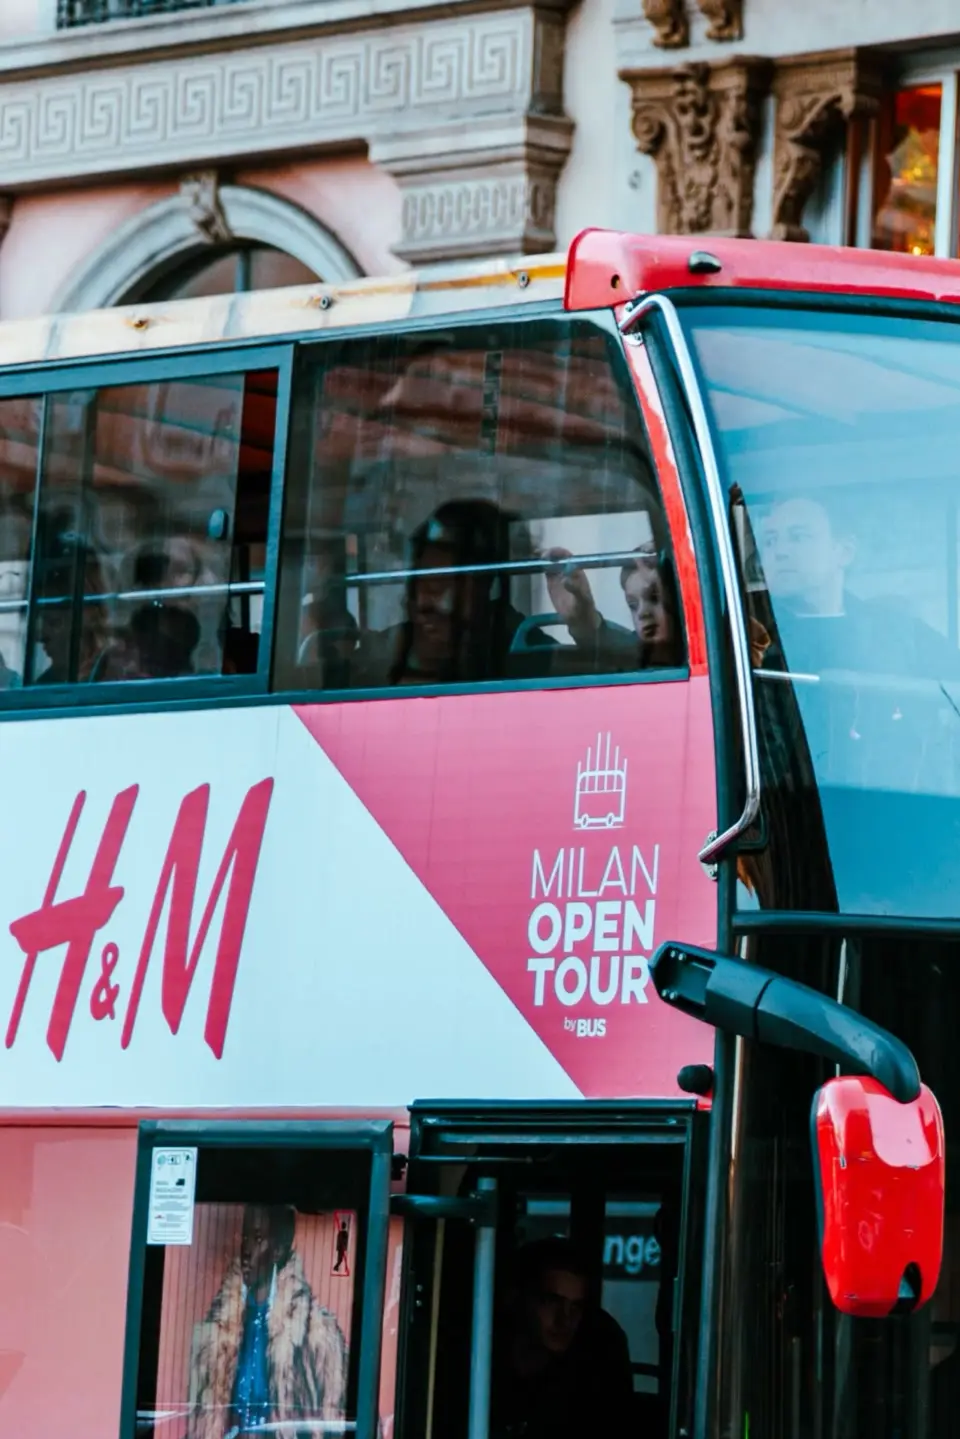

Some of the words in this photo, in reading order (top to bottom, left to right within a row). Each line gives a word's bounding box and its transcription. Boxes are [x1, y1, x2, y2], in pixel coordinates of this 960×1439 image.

[530, 843, 660, 899] MILAN
[5, 776, 275, 1062] H&M
[527, 899, 656, 954] OPEN
[526, 955, 651, 1007] TOUR
[563, 1017, 576, 1031] by
[576, 1018, 607, 1037] BUS
